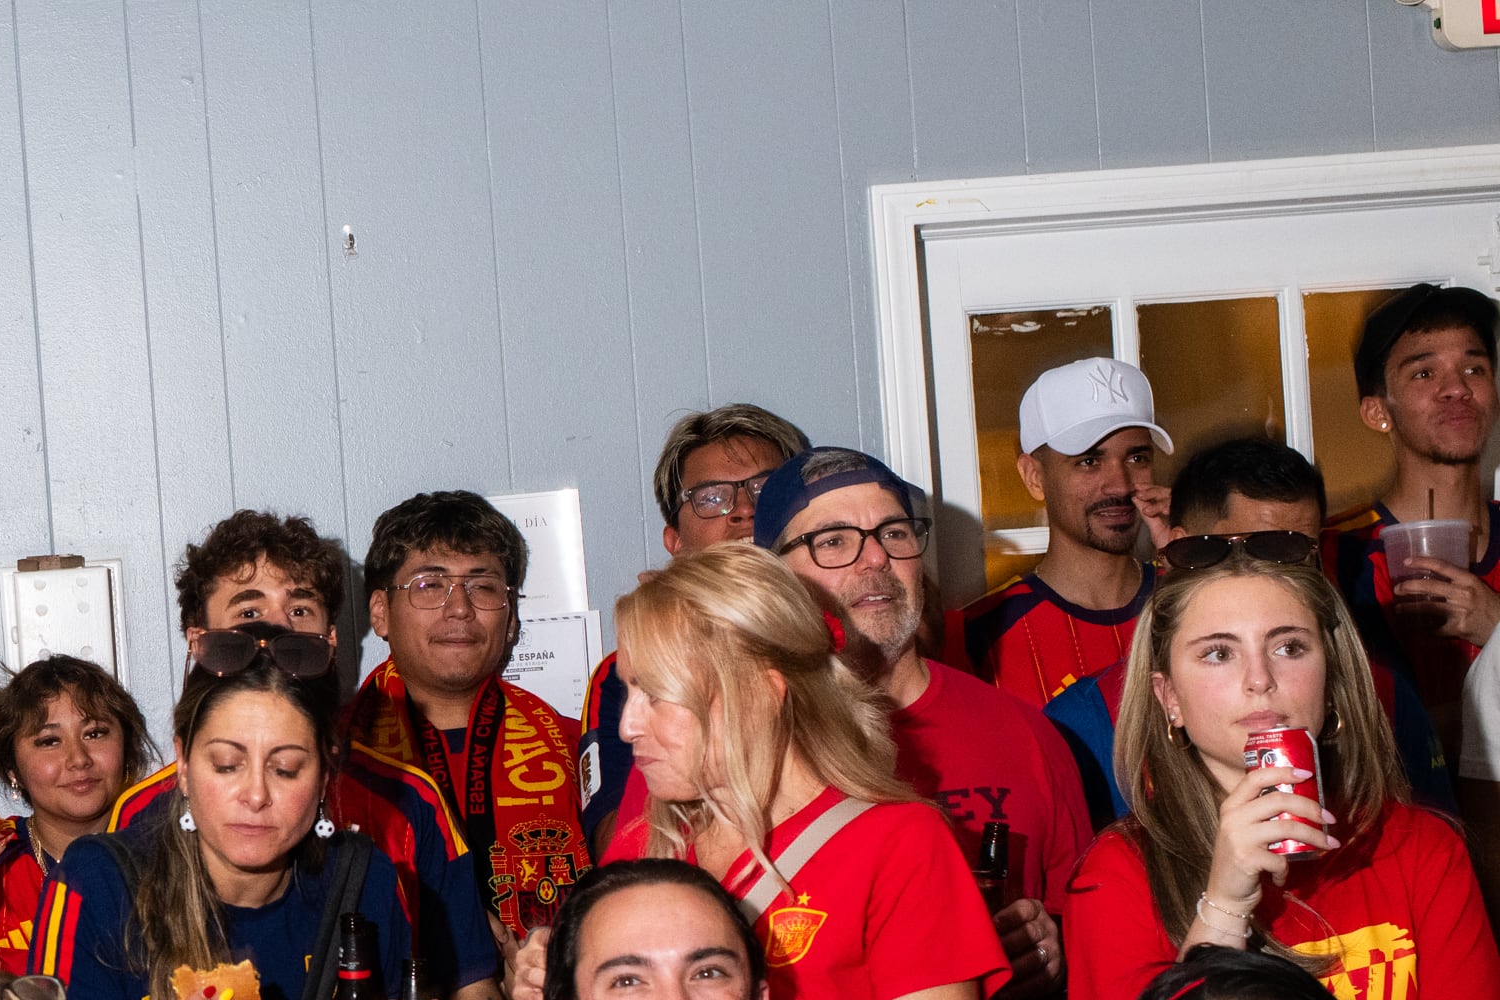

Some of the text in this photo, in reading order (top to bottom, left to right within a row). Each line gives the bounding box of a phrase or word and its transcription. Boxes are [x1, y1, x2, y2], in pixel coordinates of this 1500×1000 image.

[525, 515, 548, 528] DÍA
[519, 649, 556, 661] ESPAÑA
[932, 786, 1011, 822] EY
